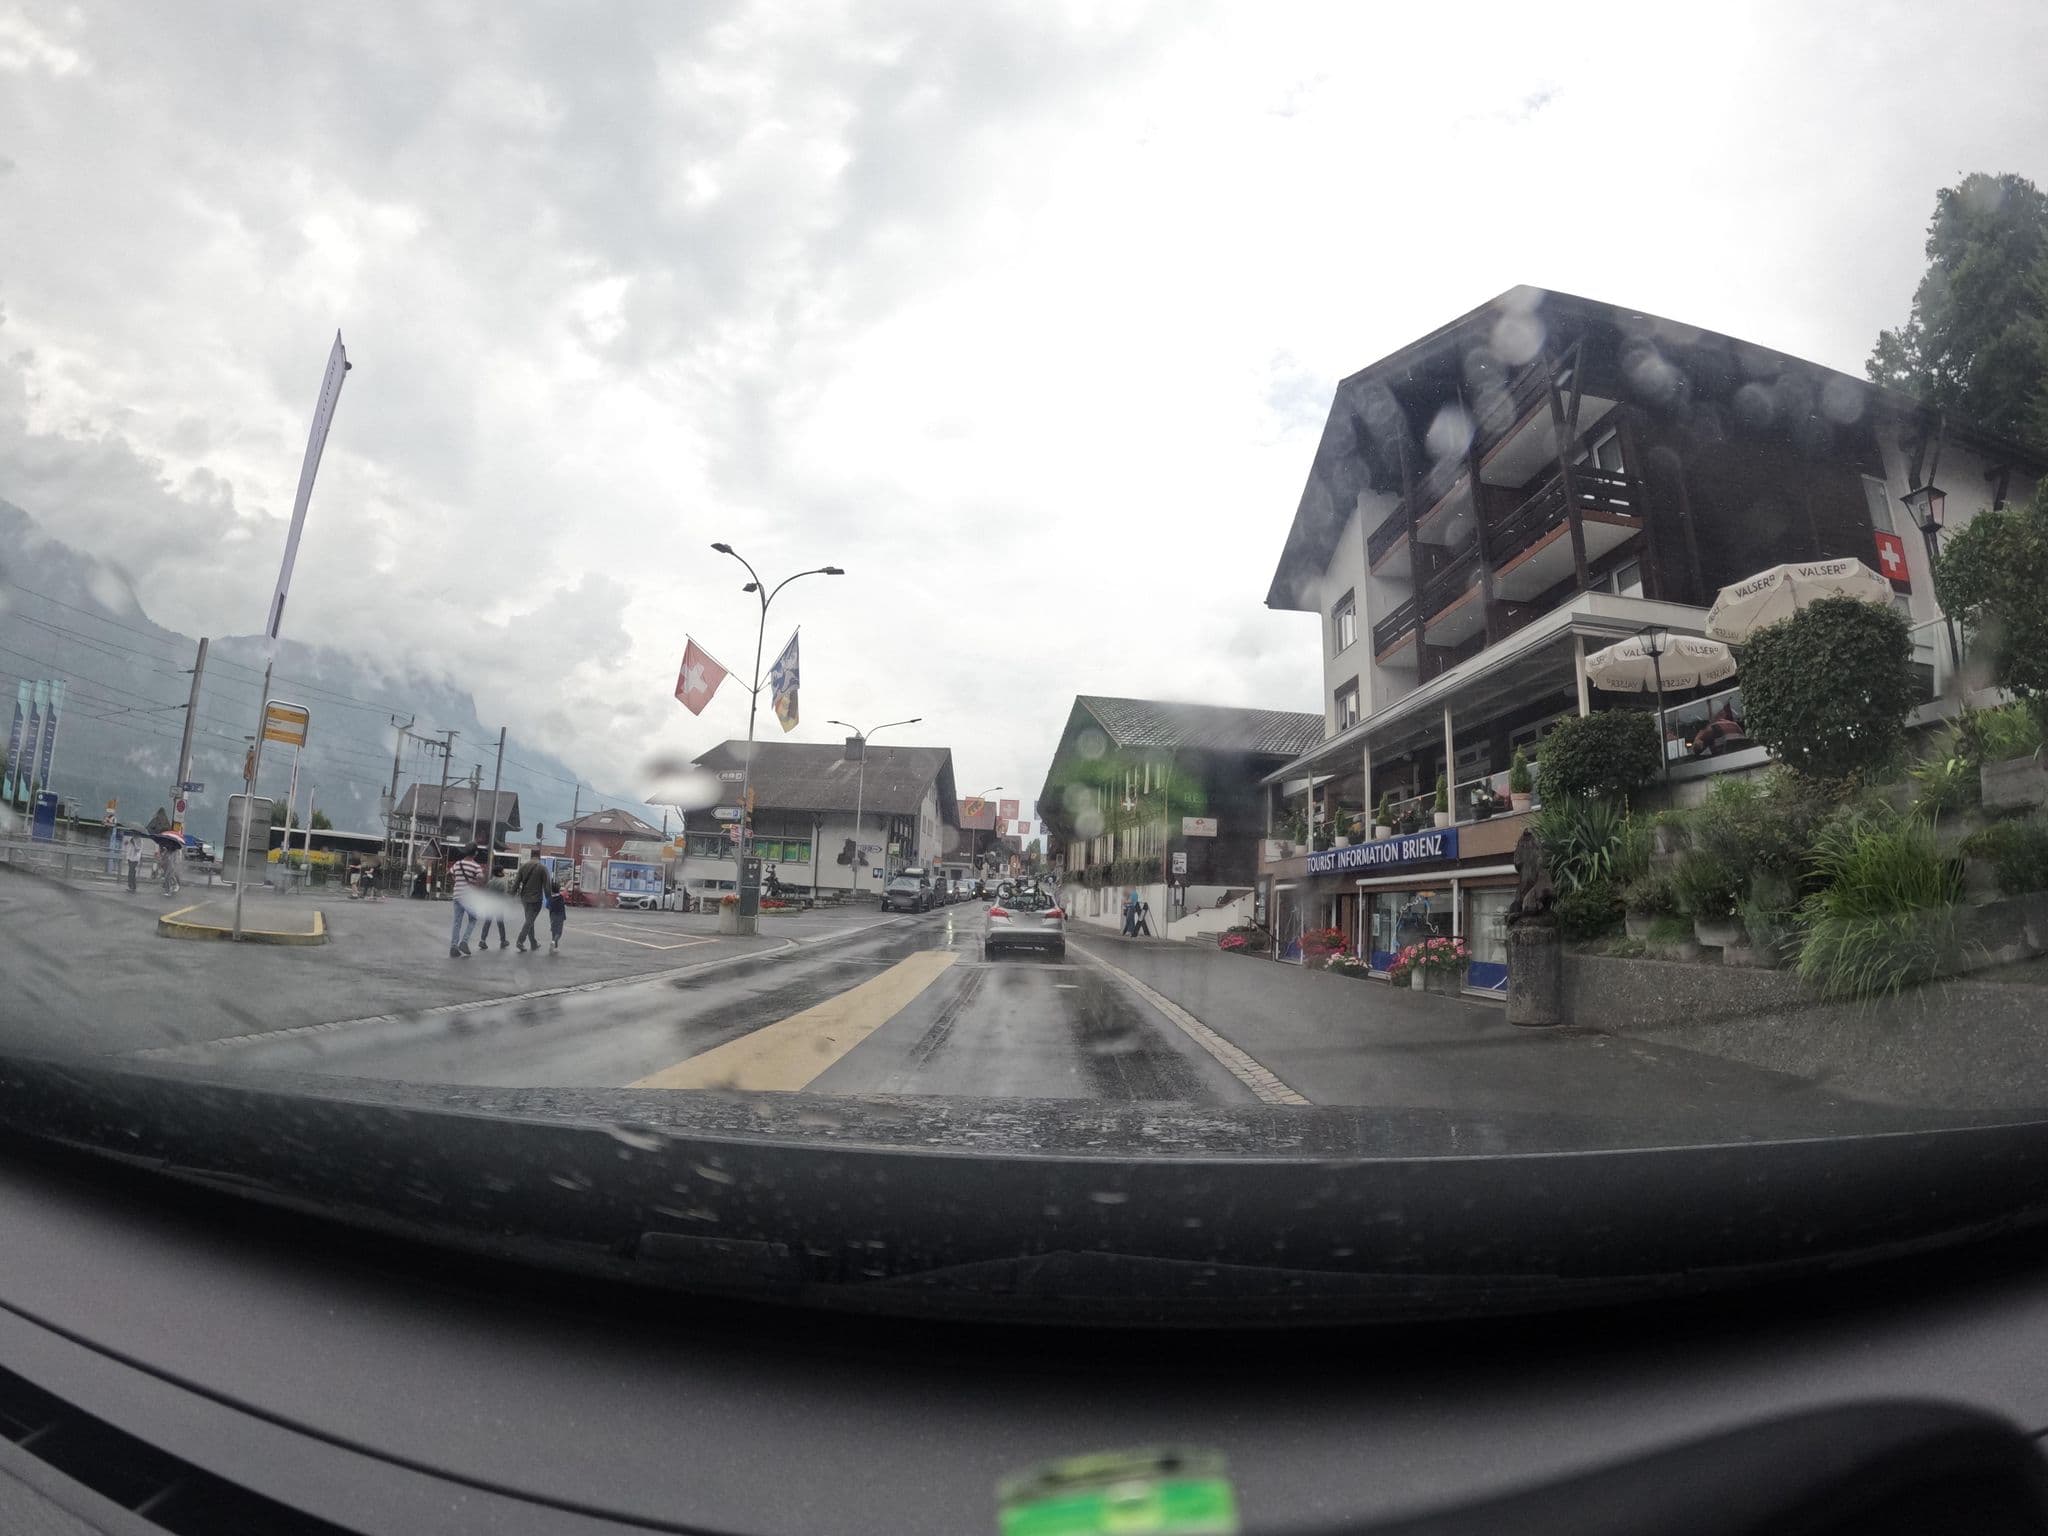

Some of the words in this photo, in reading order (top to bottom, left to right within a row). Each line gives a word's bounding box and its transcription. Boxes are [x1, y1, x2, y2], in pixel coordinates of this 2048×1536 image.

[1798, 564, 1842, 577] VALSER
[1734, 578, 1771, 598] VALSER
[1307, 853, 1335, 872] TOURIST
[1337, 843, 1399, 868] INFORMATION
[1403, 834, 1442, 860] BRIENZ
